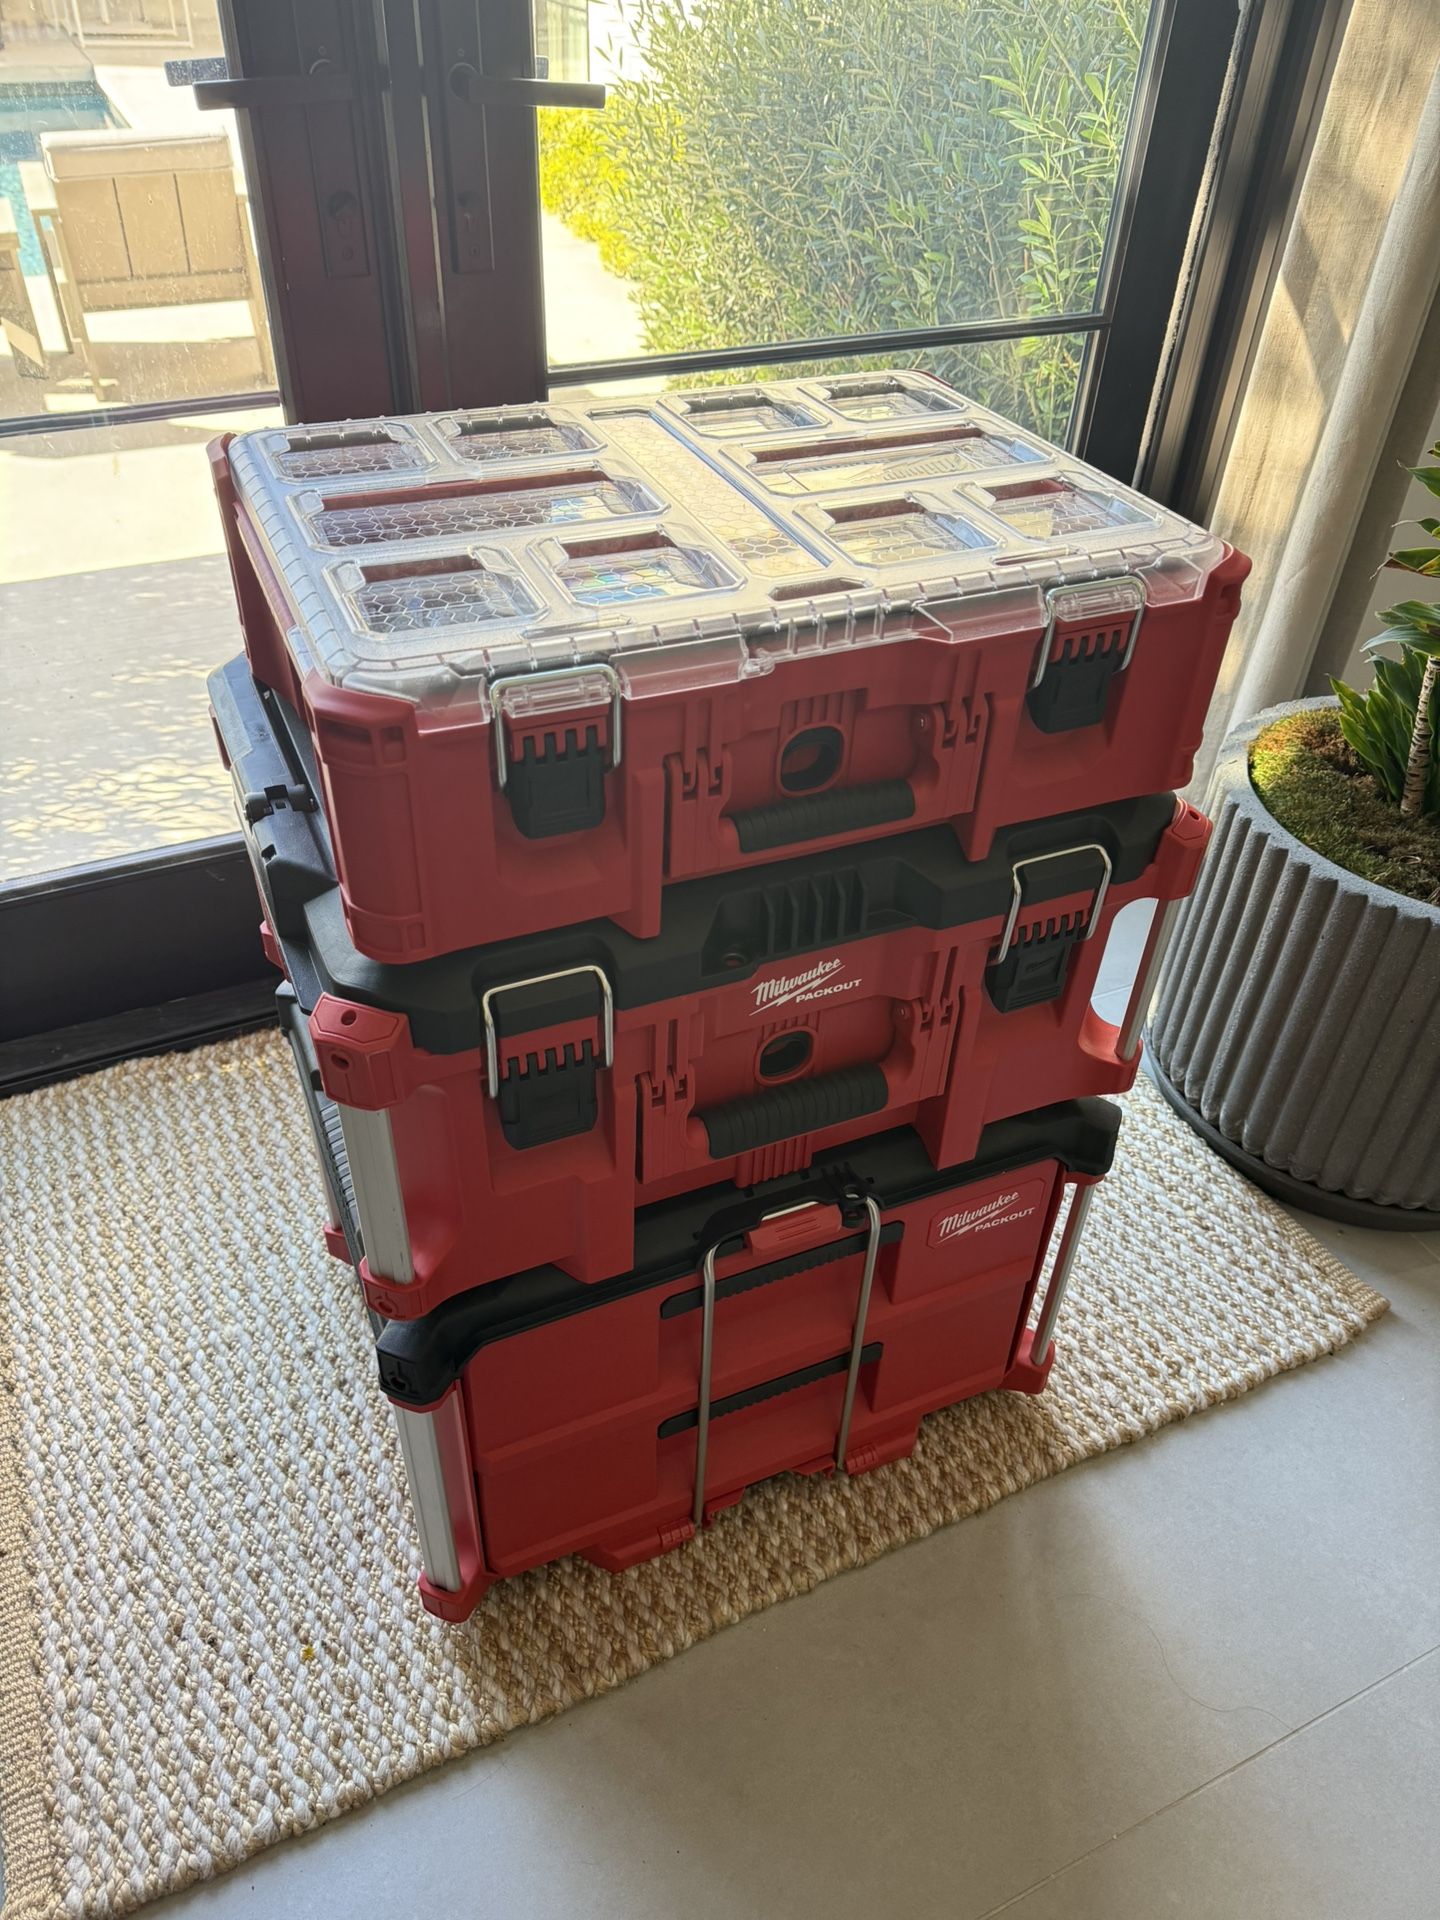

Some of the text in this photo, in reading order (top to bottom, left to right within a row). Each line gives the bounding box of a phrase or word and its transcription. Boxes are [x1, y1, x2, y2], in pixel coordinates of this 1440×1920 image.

[751, 958, 842, 1006] Milwaukee
[796, 979, 862, 1003] PACKOUT
[937, 1192, 1019, 1237] Milwaukee
[975, 1207, 1035, 1232] PACKOUT
